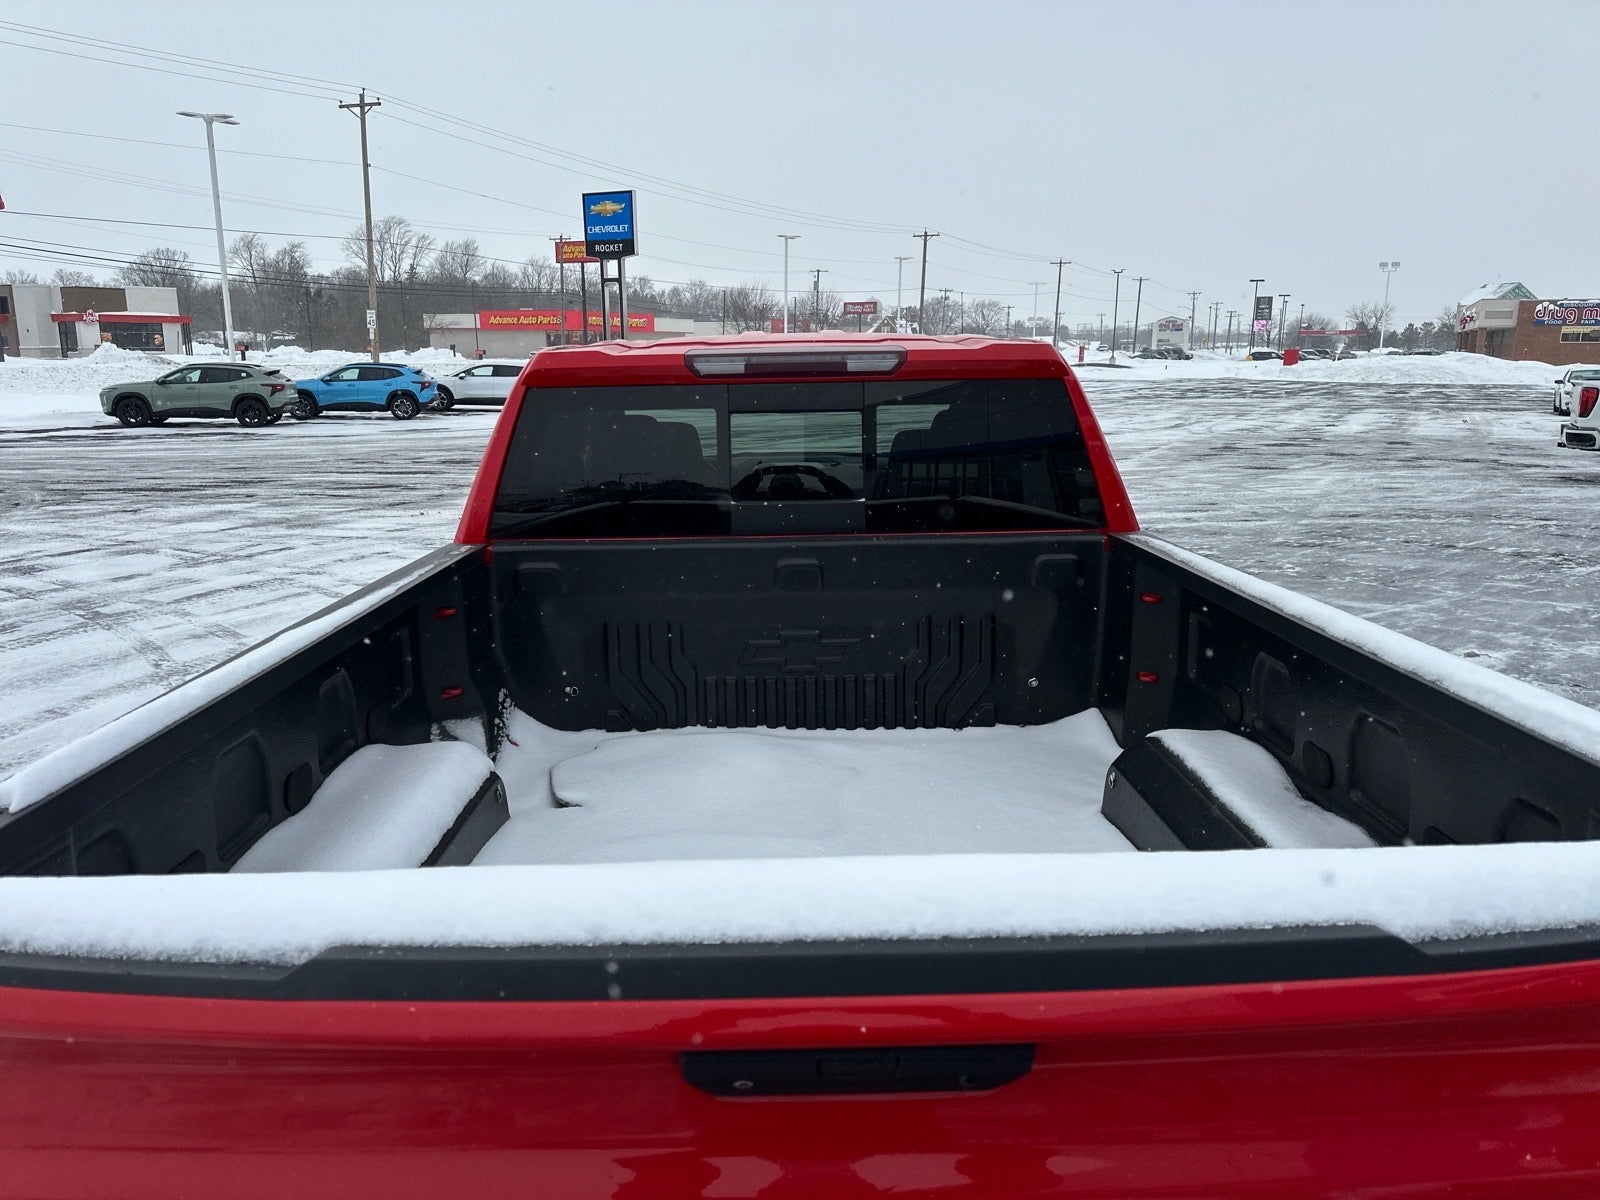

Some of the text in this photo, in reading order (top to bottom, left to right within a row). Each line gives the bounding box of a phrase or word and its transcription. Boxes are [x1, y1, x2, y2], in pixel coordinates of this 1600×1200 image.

[587, 225, 628, 234] CHEVROLET
[595, 243, 623, 252] ROCKET
[1533, 302, 1578, 325] drug
[489, 315, 557, 324] Advance Auto Parts
